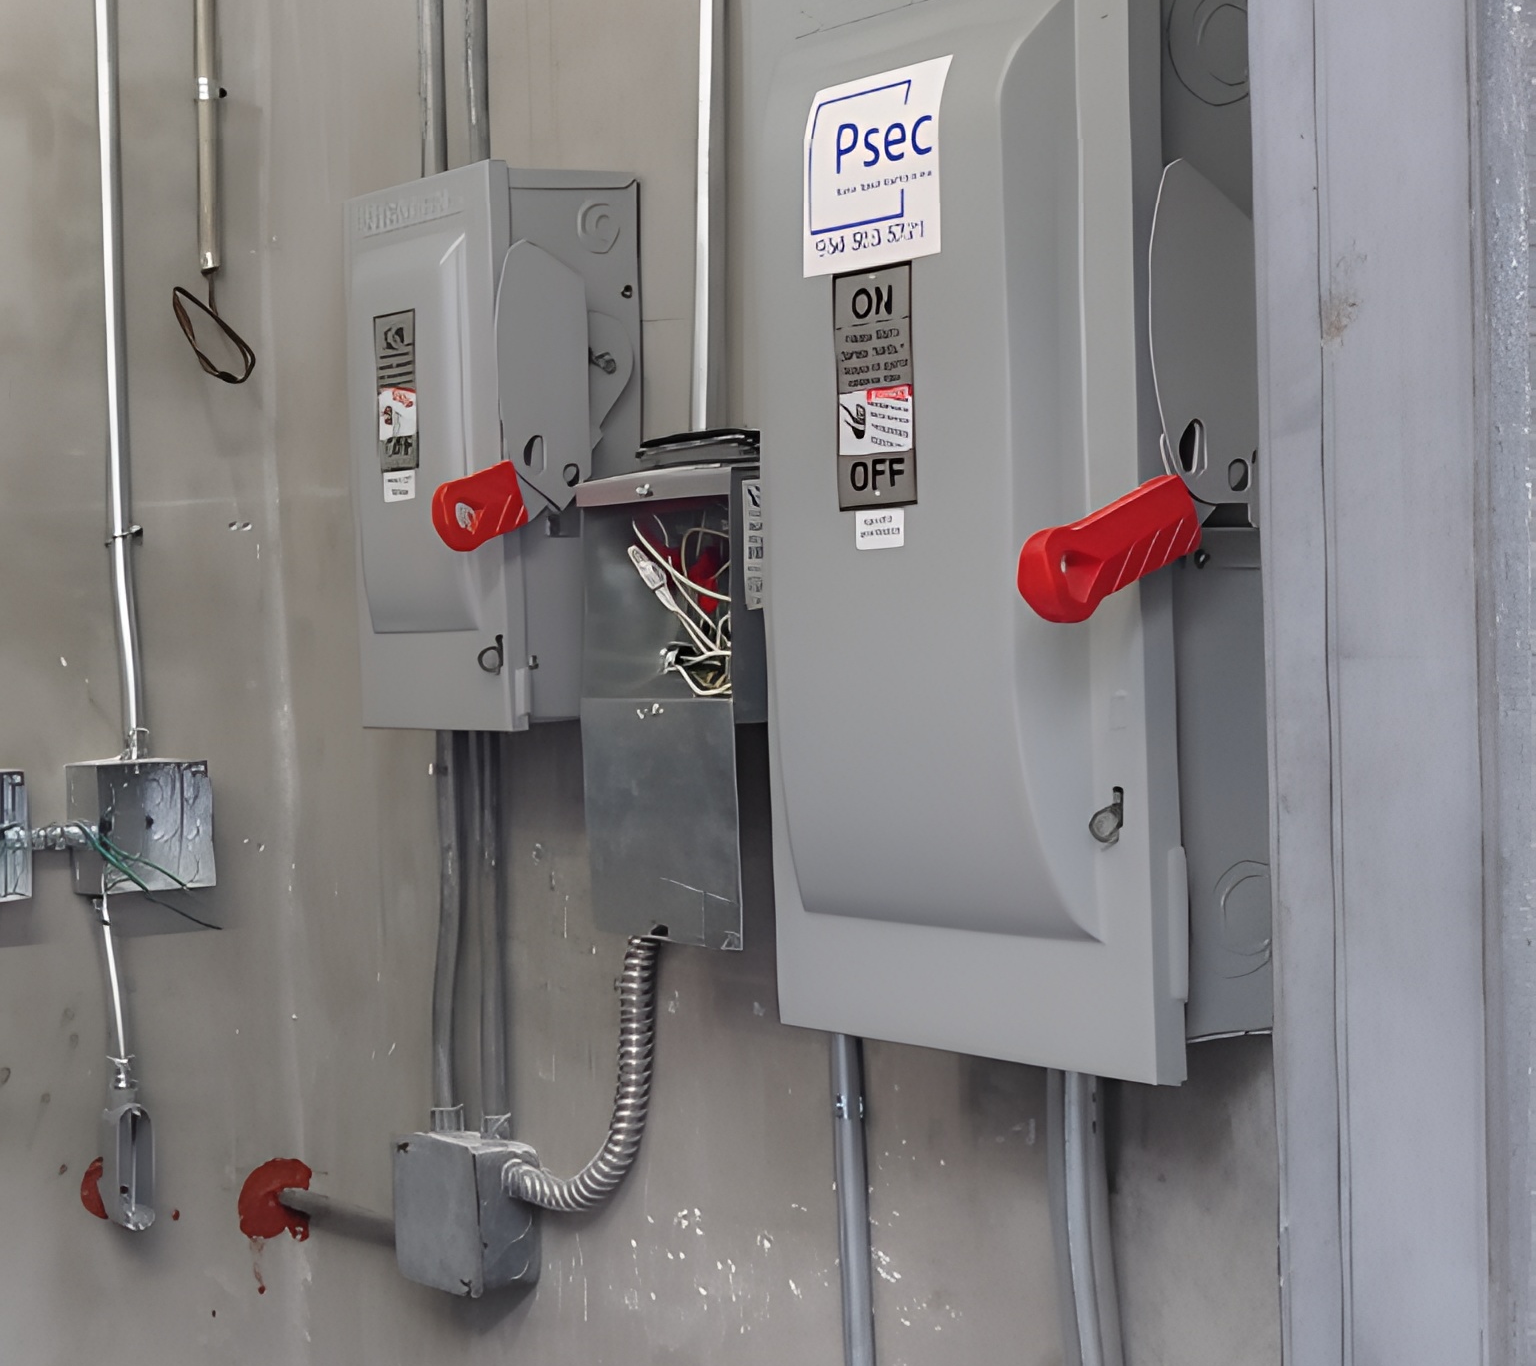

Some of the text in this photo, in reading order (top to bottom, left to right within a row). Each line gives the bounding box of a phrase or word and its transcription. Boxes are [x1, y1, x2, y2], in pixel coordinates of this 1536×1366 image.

[836, 115, 933, 174] Psec
[851, 284, 893, 320] ON
[850, 457, 905, 492] OFF
